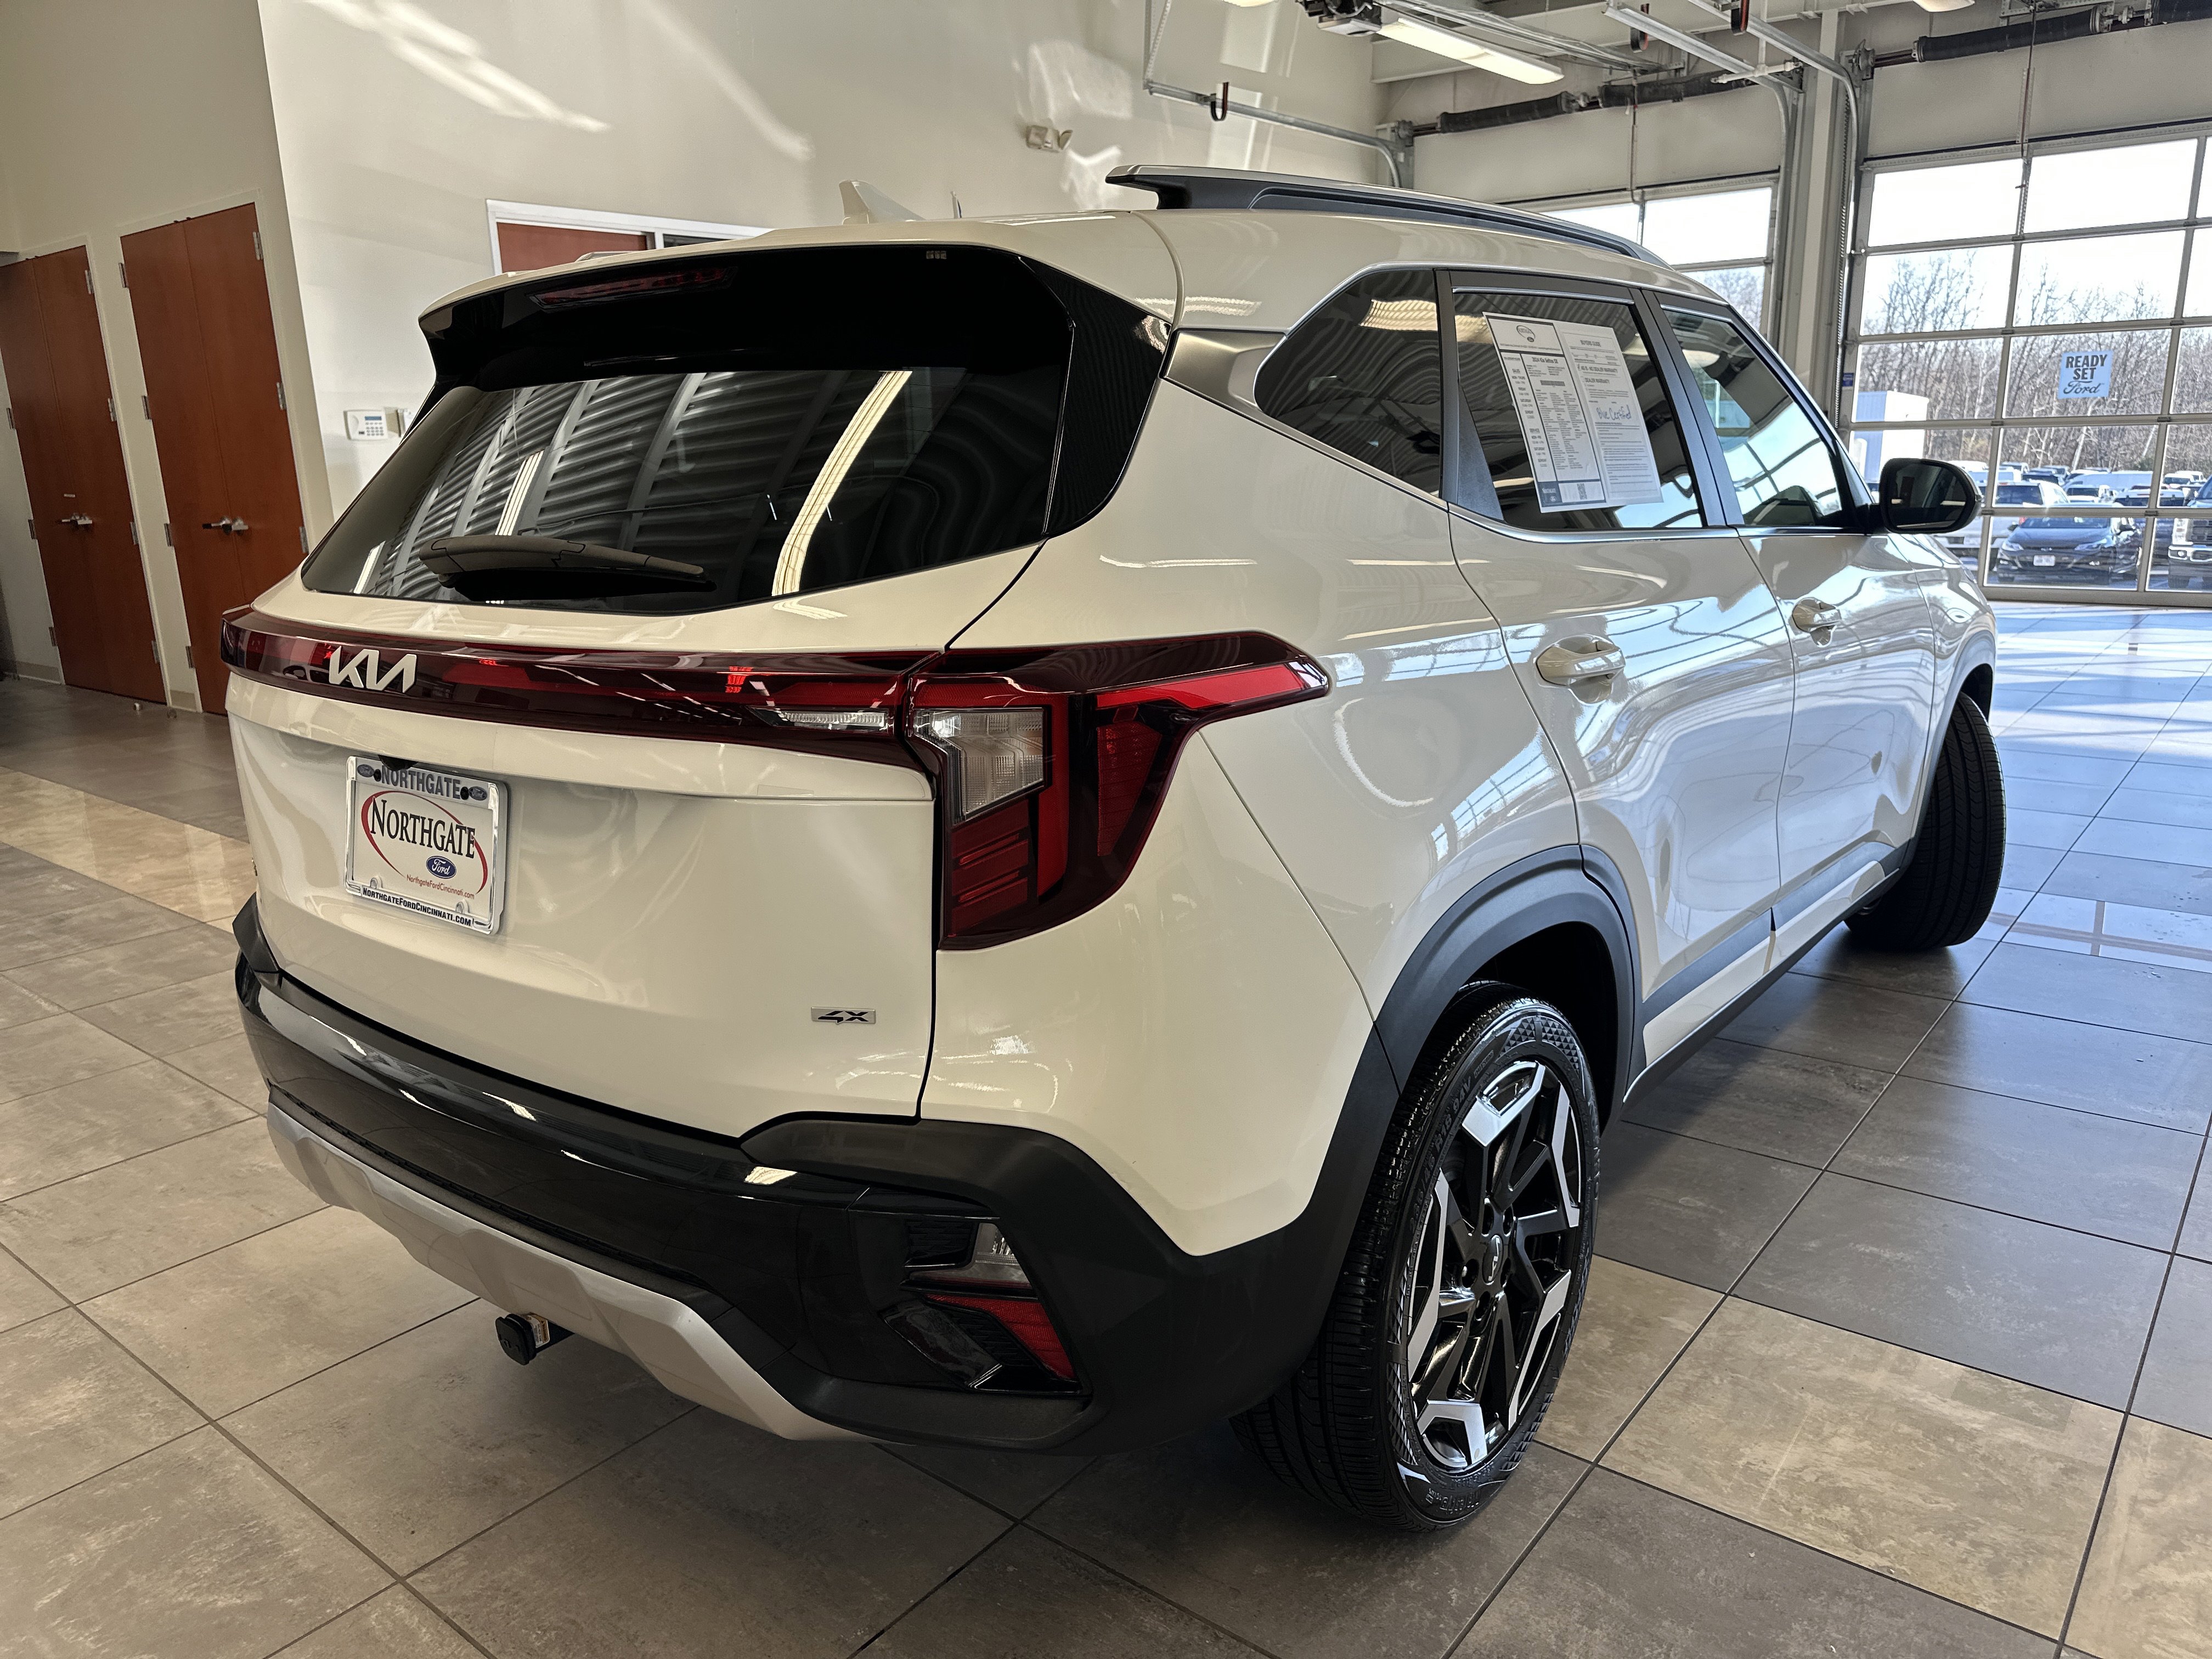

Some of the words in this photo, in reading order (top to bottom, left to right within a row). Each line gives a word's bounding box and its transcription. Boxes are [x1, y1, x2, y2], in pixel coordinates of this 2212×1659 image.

[2066, 354, 2107, 368] READY
[2073, 368, 2096, 380] SET
[2063, 381, 2105, 394] Ford
[329, 645, 417, 693] KIA
[381, 765, 460, 799] NORTHGATE
[370, 797, 476, 859] NORTHGATE
[431, 858, 451, 876] Ford
[406, 874, 475, 900] NorthgateFordCincinnati.com
